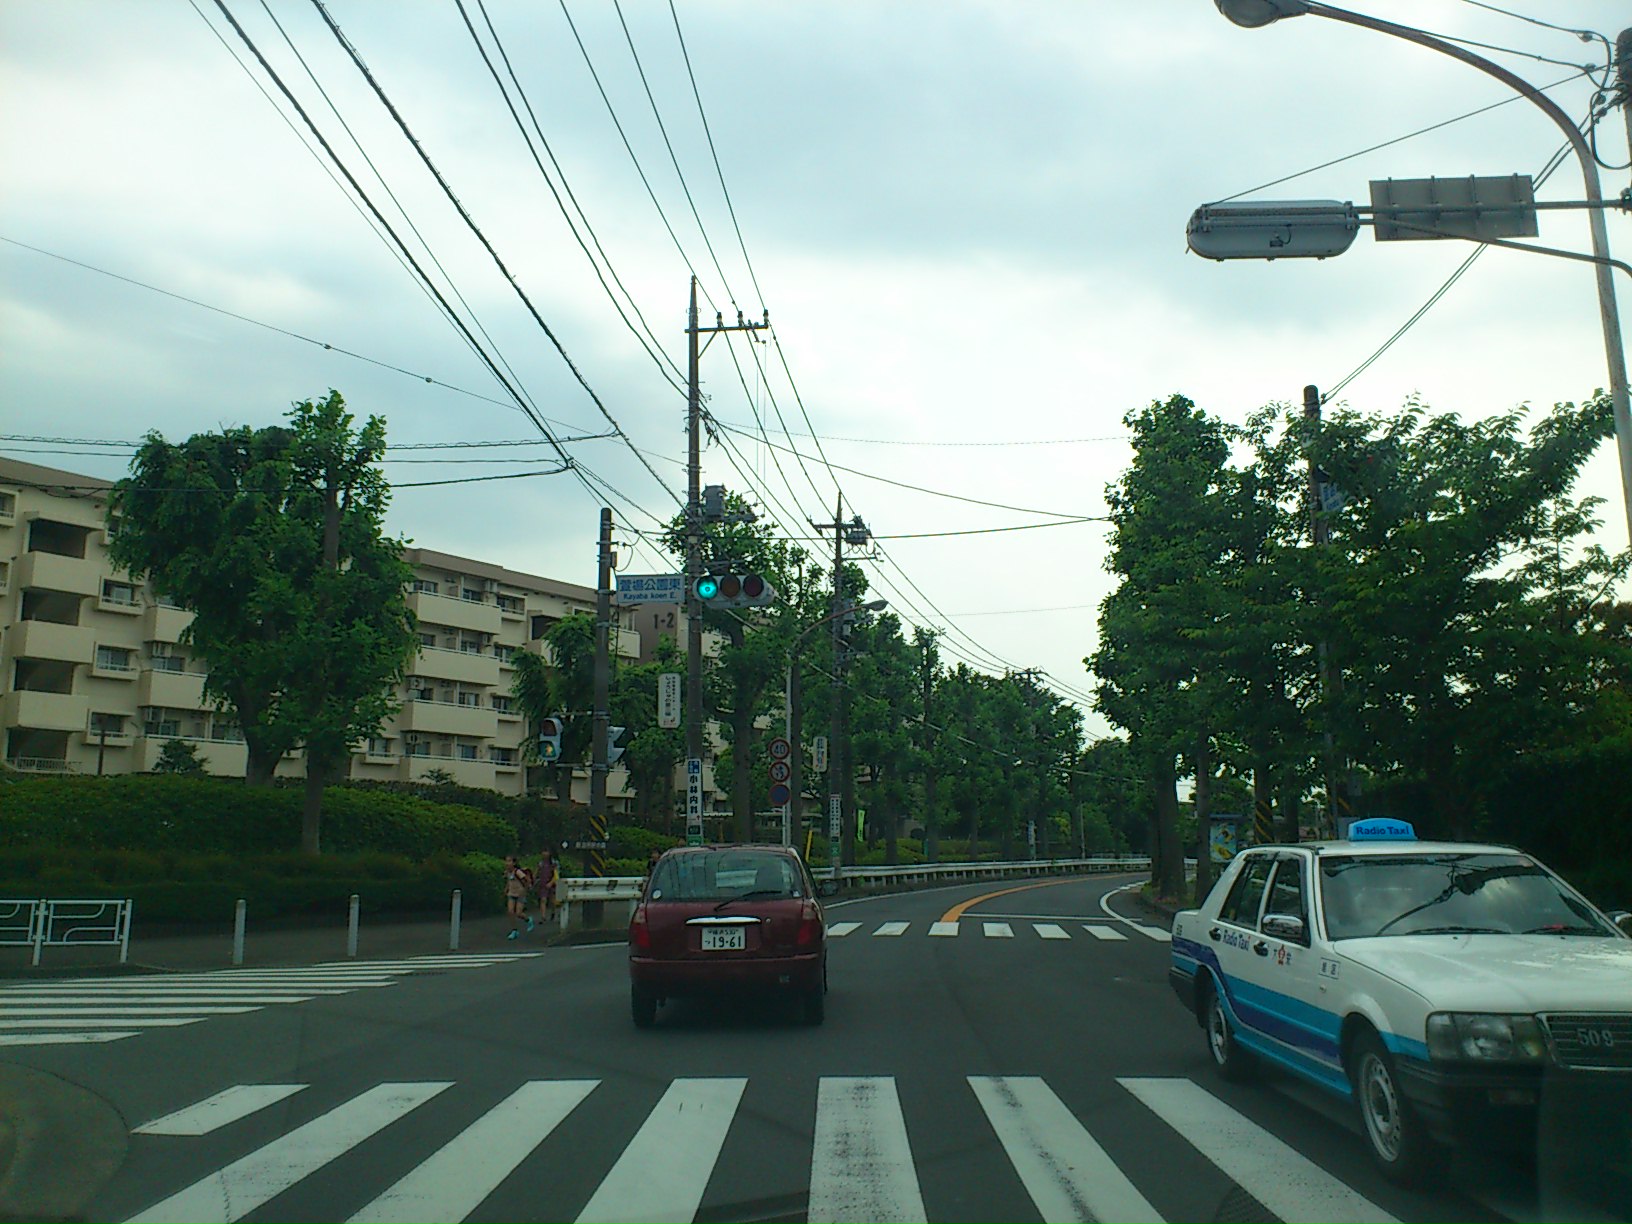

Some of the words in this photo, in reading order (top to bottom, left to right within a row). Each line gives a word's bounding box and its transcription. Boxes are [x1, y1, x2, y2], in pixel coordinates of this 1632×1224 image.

[653, 612, 674, 629] 1-2
[773, 744, 786, 754] 40
[1356, 826, 1386, 835] Radio
[1386, 826, 1410, 835] Taxi
[1222, 929, 1238, 948] Radio
[1238, 933, 1251, 952] Taxi
